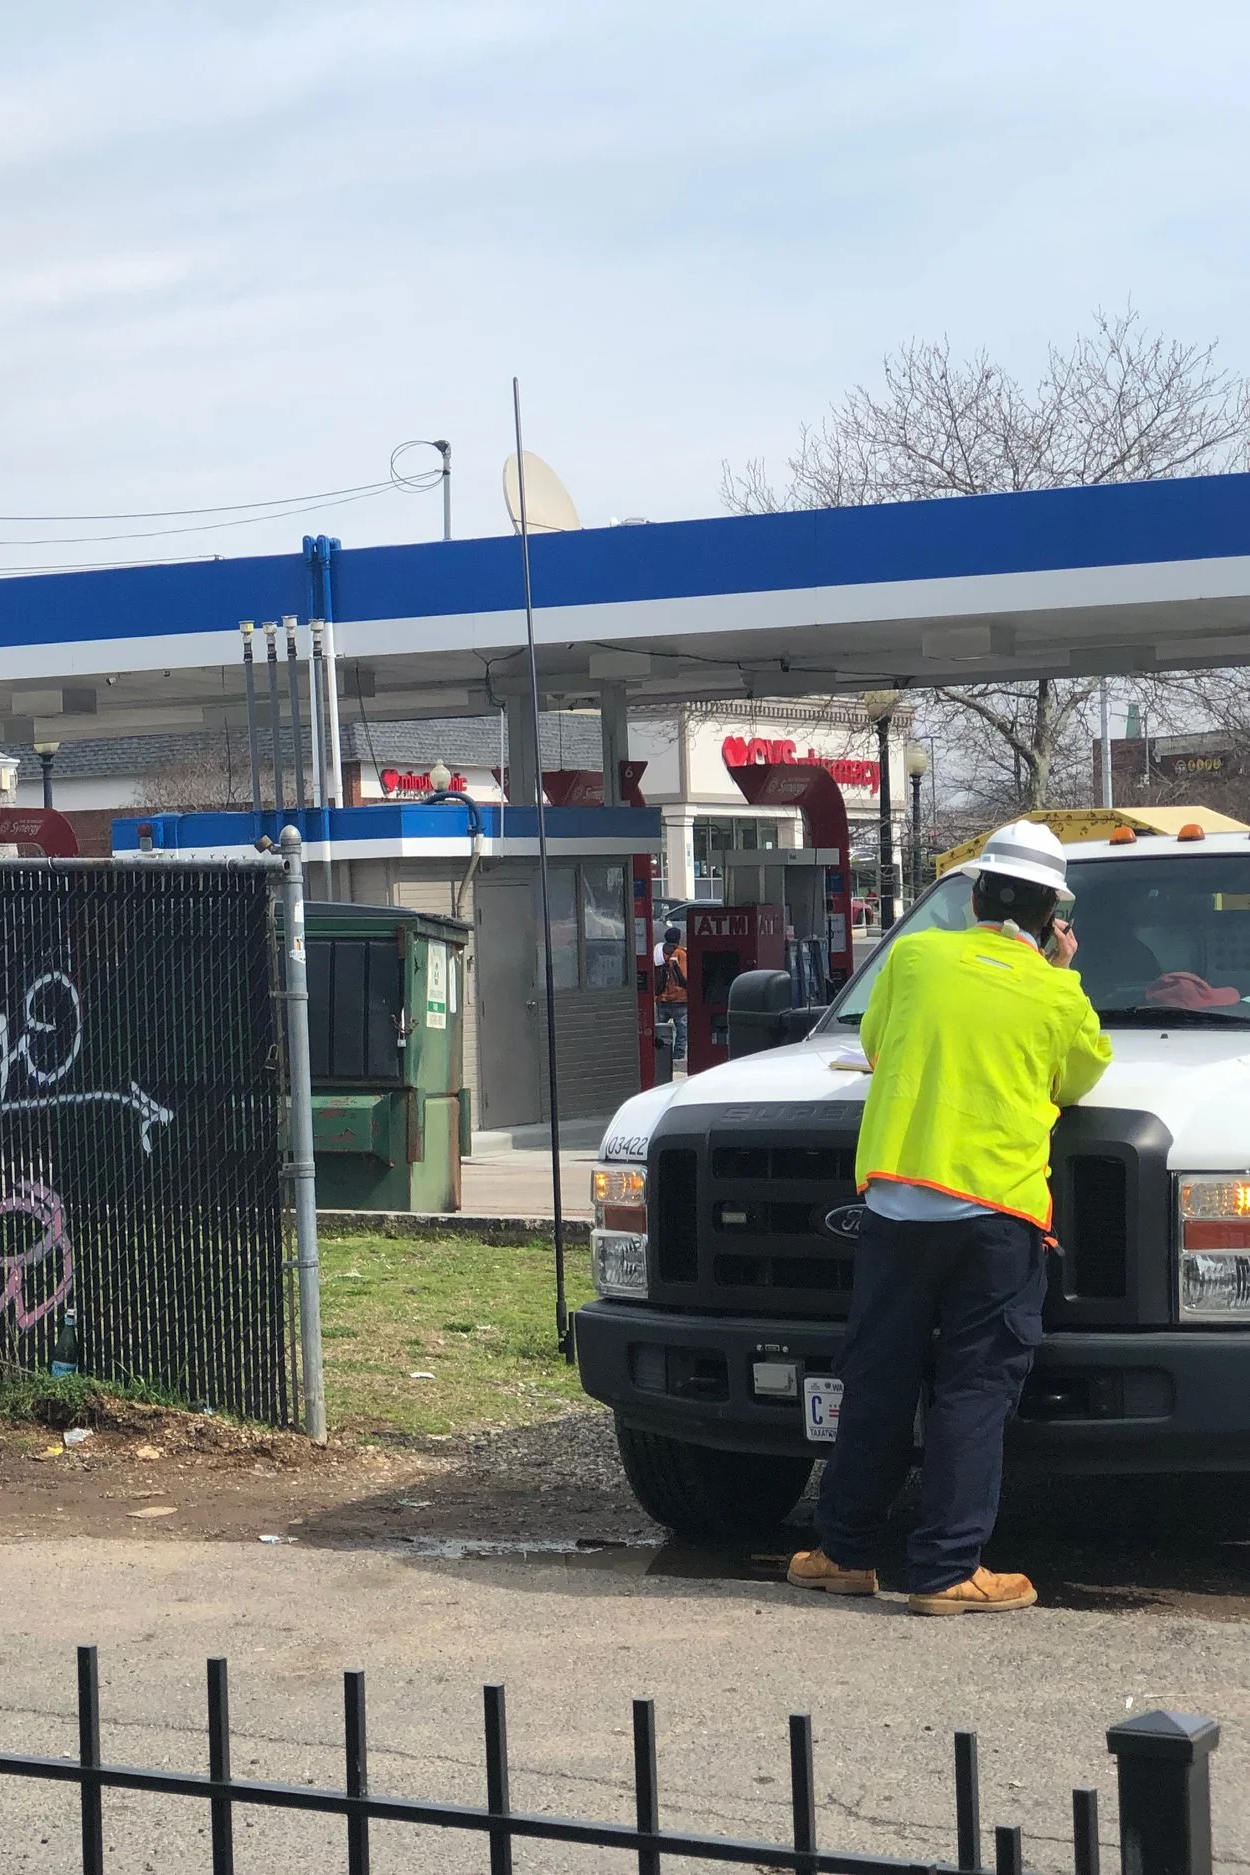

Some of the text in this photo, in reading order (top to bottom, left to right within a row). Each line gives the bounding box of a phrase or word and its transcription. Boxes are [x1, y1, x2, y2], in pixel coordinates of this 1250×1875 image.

[625, 766, 634, 778] 6
[10, 821, 42, 836] Synergy
[698, 915, 747, 936] ATM
[608, 1136, 649, 1156] 03422
[812, 1395, 823, 1425] C
